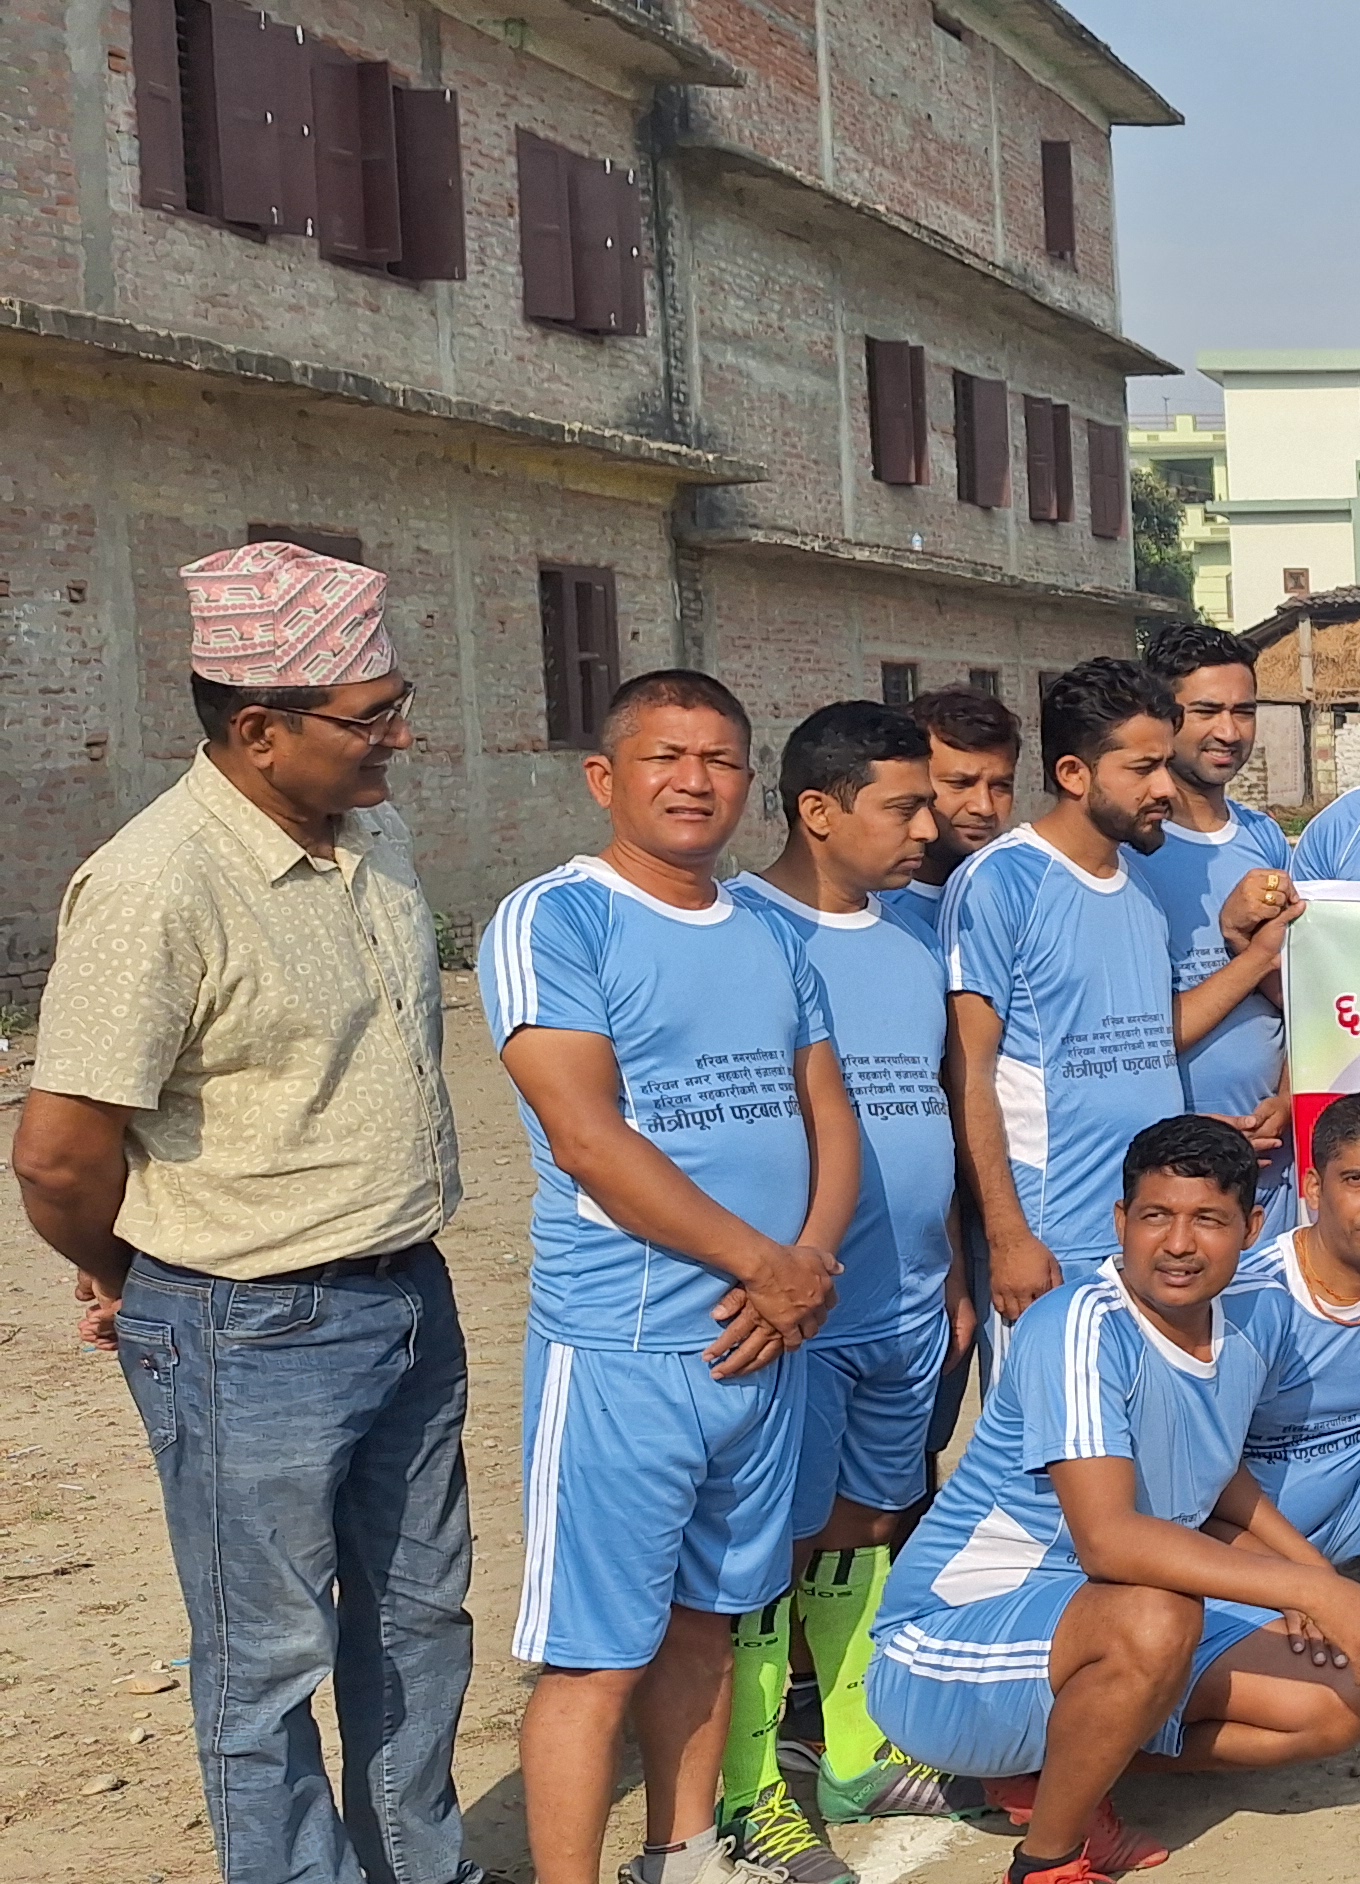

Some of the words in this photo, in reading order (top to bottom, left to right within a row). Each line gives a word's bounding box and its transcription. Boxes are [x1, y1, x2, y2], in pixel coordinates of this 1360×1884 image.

[695, 1053, 728, 1069] हरिवन
[640, 1079, 679, 1095] हरिवन
[684, 1074, 711, 1088] नगर
[716, 1066, 752, 1081] सहकारी
[857, 1068, 891, 1081] सहकारी
[653, 1093, 691, 1109] हरिवन
[646, 1103, 725, 1133] मैत्रीपूर्ण
[729, 1101, 784, 1124] फुटबल
[866, 1101, 920, 1121] फुटबल
